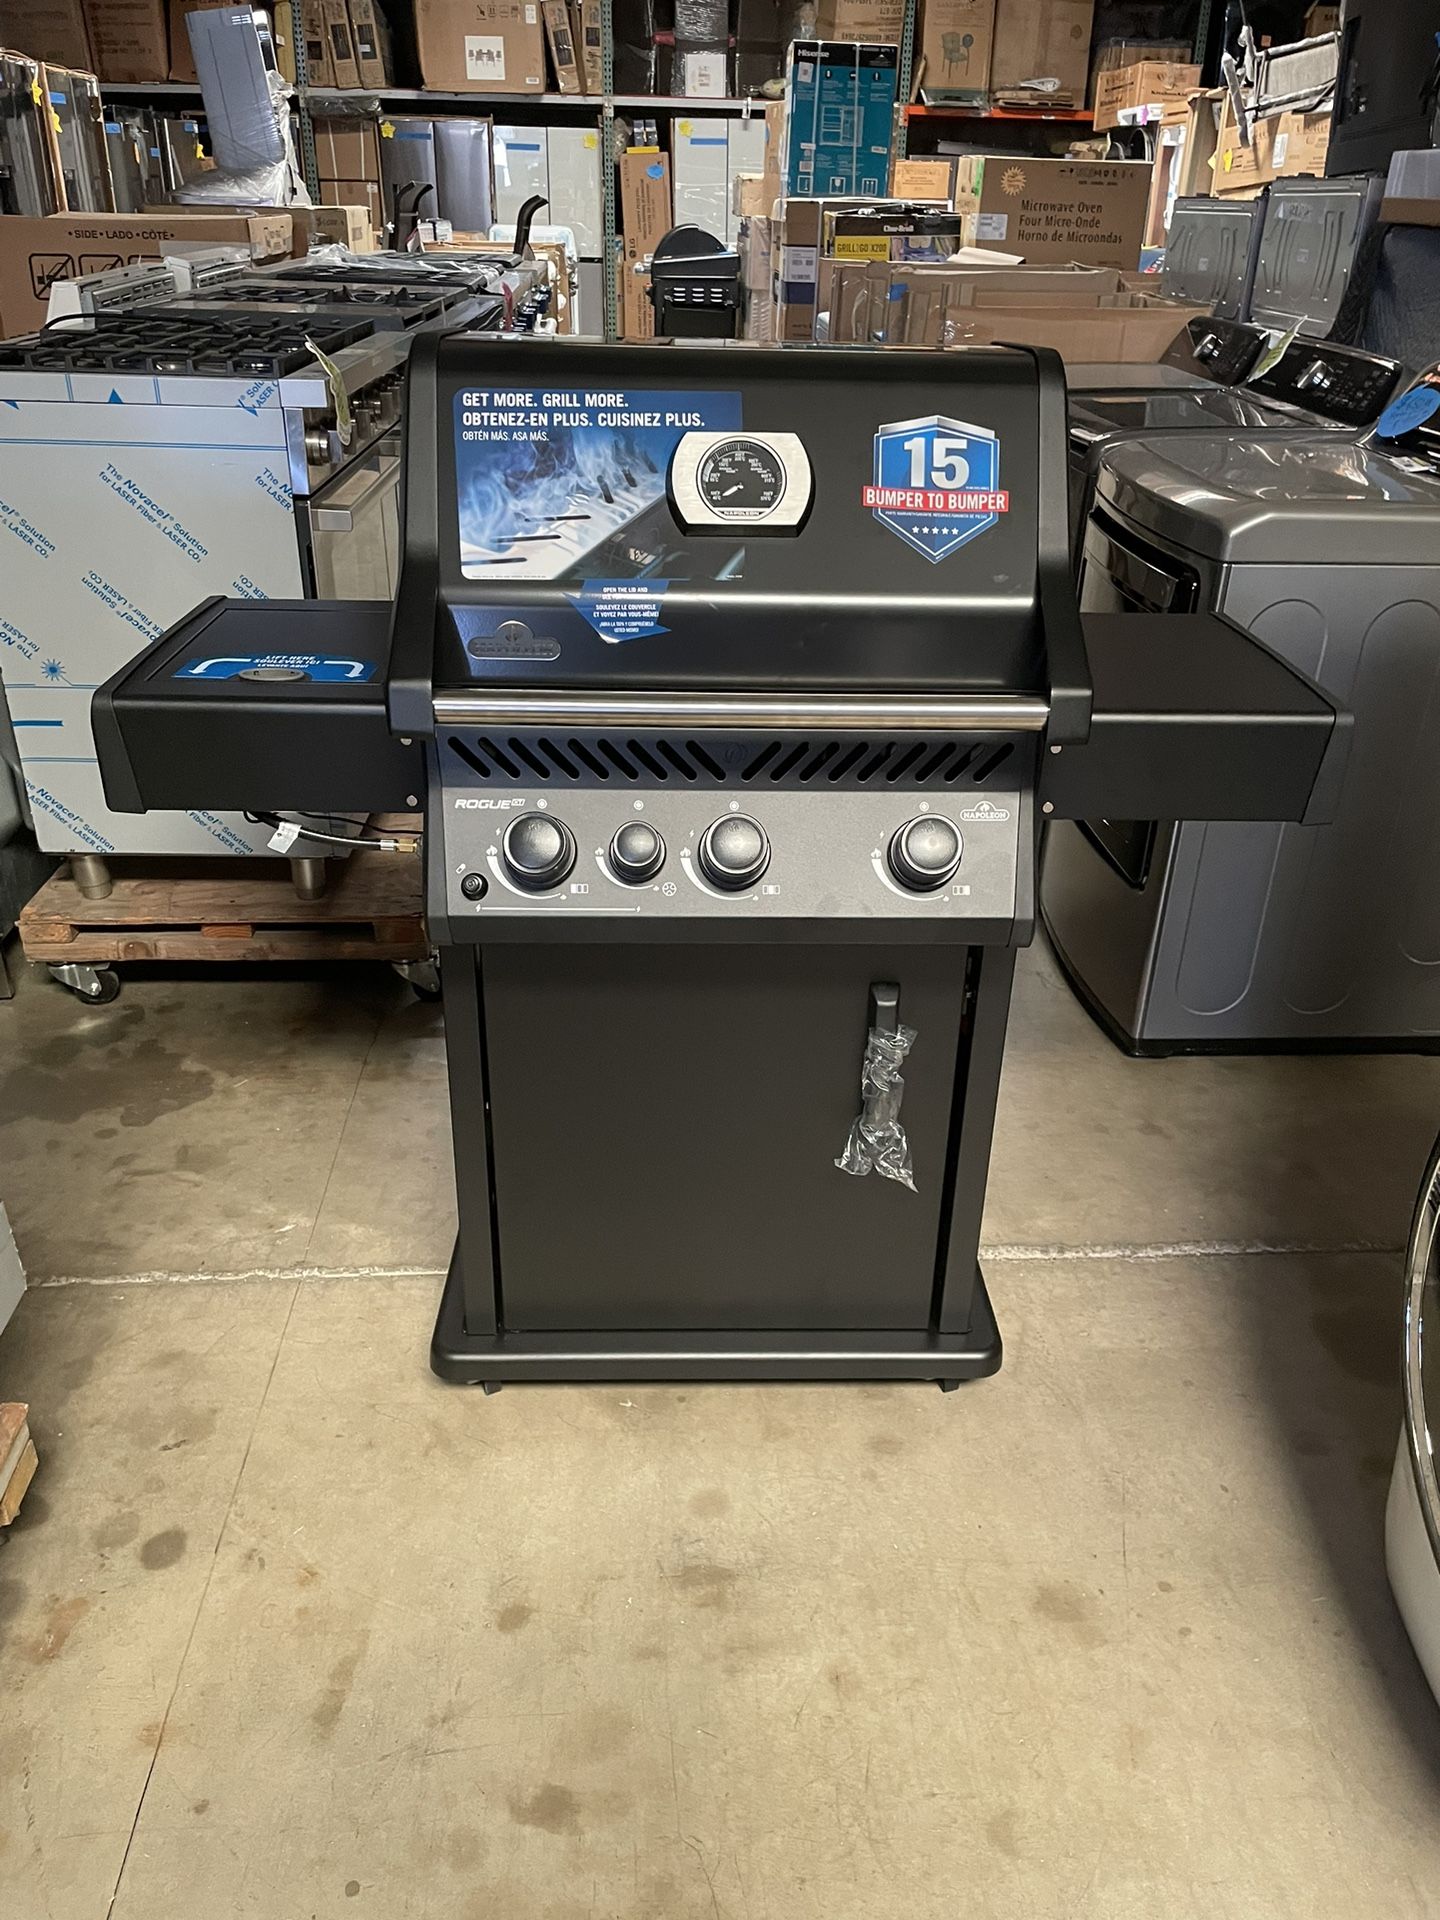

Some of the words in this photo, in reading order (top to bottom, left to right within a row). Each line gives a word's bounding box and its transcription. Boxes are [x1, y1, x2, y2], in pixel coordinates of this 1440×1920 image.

[1021, 199, 1074, 213] Microwave
[1077, 201, 1103, 214] Oven
[1019, 214, 1041, 227] Four
[1045, 215, 1101, 229] Micro-Onde
[75, 230, 98, 239] SIDE
[106, 230, 133, 239] LADO
[629, 238, 636, 249] LG
[1017, 229, 1048, 242] Horno
[1051, 230, 1063, 242] de
[1066, 231, 1122, 245] Microondas
[462, 393, 489, 407] GET
[493, 393, 538, 407] MORE.
[542, 393, 580, 407] GRILL
[585, 393, 629, 408] MORE.
[462, 412, 548, 427] OBTENEZ-EN
[553, 412, 593, 427] PLUS.
[597, 412, 661, 427] CUISINEZ
[665, 412, 705, 427] PLUS.
[462, 430, 489, 441] OBTÉN
[490, 430, 511, 441] MÁS.
[512, 431, 528, 441] ASA
[529, 430, 550, 442] MÁS.
[903, 437, 970, 490] 15
[263, 467, 279, 485] The
[255, 475, 267, 488] for
[266, 486, 292, 510] LASER
[866, 490, 924, 508] BUMPER
[927, 493, 944, 509] TO
[948, 493, 1006, 510] BUMPER
[99, 471, 112, 484] for
[111, 482, 137, 506] LASER
[136, 504, 157, 524] Fiber
[162, 526, 188, 550] LASER
[106, 462, 123, 481] The
[173, 522, 209, 556] Solution
[8, 522, 34, 545] LASER
[19, 518, 56, 551] Solution
[81, 576, 117, 610] Solution
[102, 583, 128, 606] LASER
[132, 607, 153, 627] Fiber
[2, 621, 28, 643] LASER
[17, 644, 33, 660] The
[27, 641, 40, 652] for
[454, 799, 511, 809] ROGUE
[29, 794, 50, 811] ASER
[49, 808, 68, 824] Fiber
[72, 826, 96, 846] LASER
[189, 811, 208, 827] Fiber
[211, 827, 236, 849] LASER
[82, 823, 115, 852] Solution
[221, 826, 254, 854] Solution
